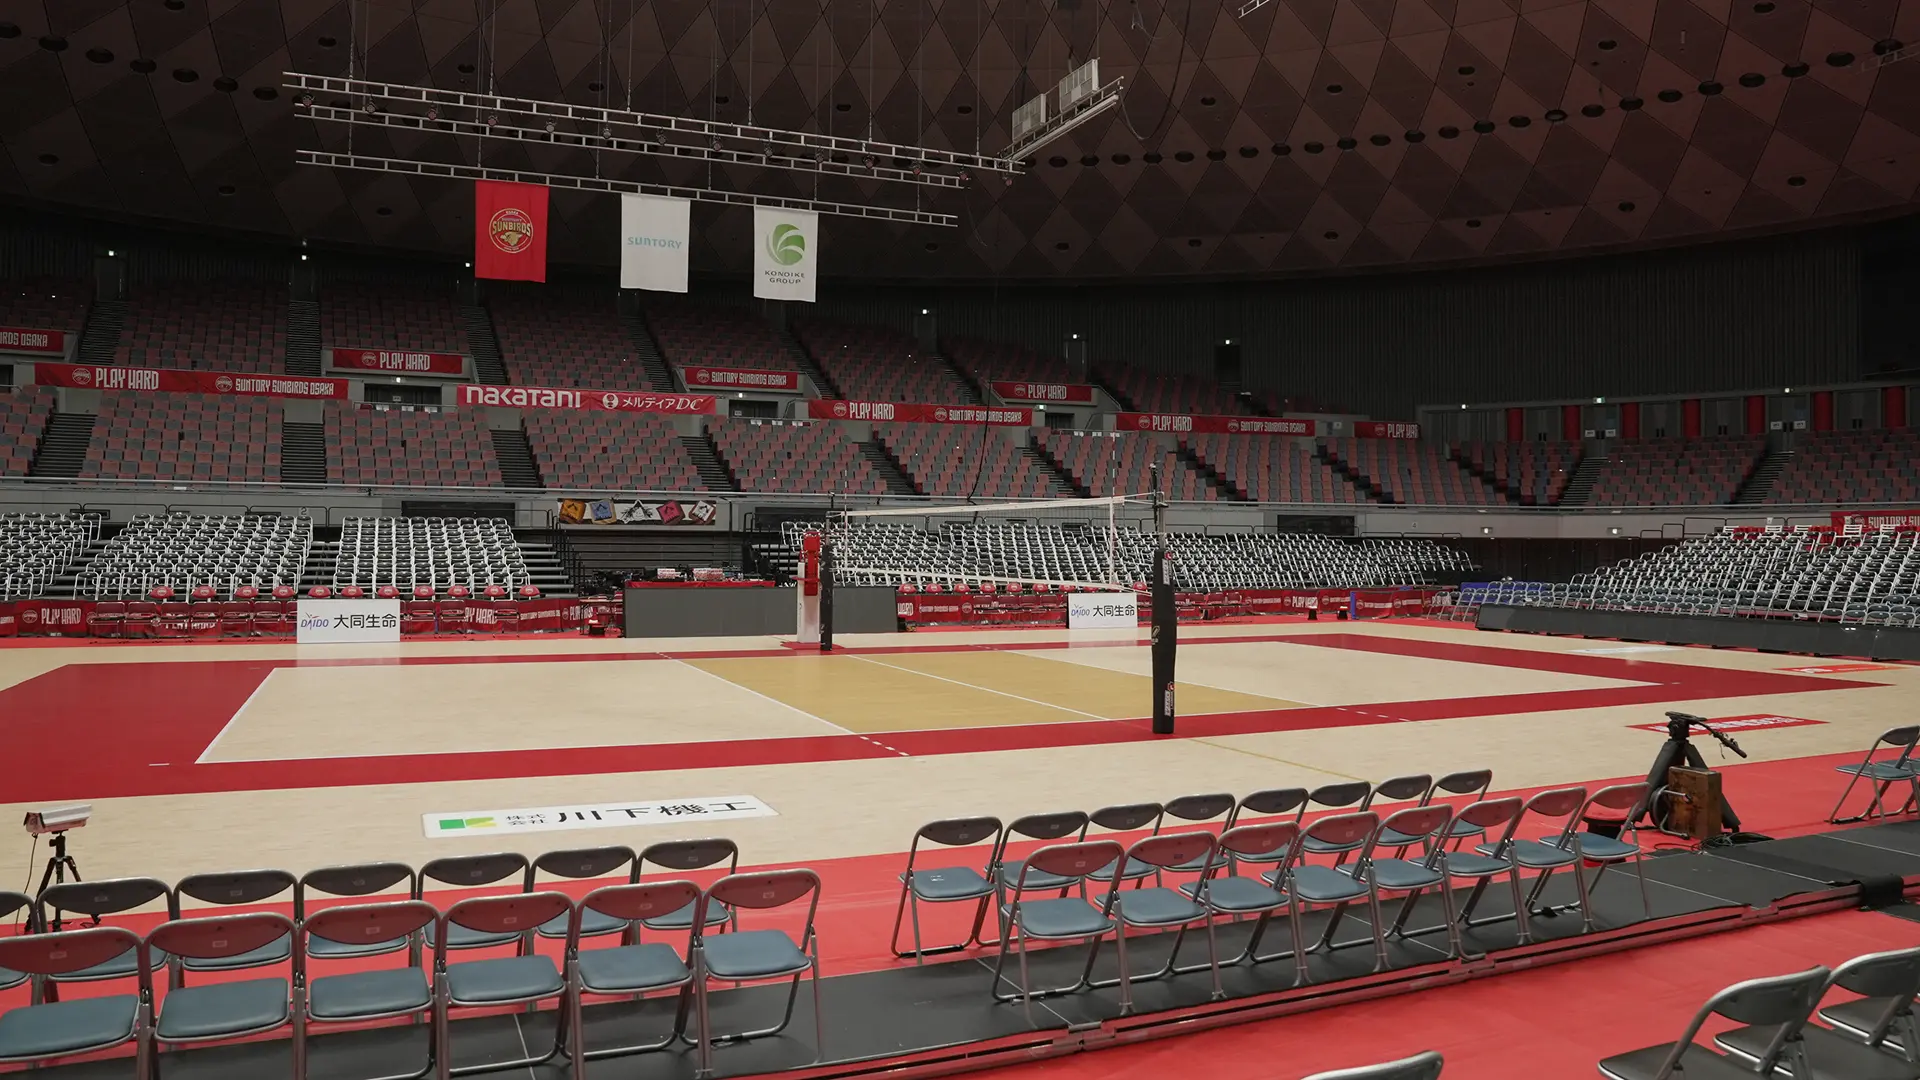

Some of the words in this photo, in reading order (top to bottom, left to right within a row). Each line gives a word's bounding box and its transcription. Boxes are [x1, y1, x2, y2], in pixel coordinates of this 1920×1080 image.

[492, 220, 531, 237] SUNBIRDS
[764, 270, 805, 278] KONOIKE
[21, 333, 48, 346] OSAKA
[380, 352, 404, 369] PLAY
[405, 353, 430, 370] HARD
[95, 368, 126, 388] PLAY
[128, 370, 159, 390] HARD
[711, 371, 738, 383] SUNTORY
[739, 373, 767, 384] SUNBIRDS
[768, 375, 787, 385] OSAKA
[235, 378, 270, 392] SUNTORY
[272, 380, 308, 394] SUNBIRDS
[310, 382, 334, 395] OSAKA
[1028, 385, 1046, 399] PLAY
[1047, 386, 1067, 399] HARD
[849, 402, 870, 419] PLAY
[872, 403, 894, 420] HARD
[949, 409, 974, 420] SUNTORY
[1152, 416, 1171, 431] PLAY
[1172, 417, 1192, 431] HARD
[1388, 424, 1405, 438] PLAY
[42, 608, 60, 624] PLAY
[61, 608, 81, 624] HARD
[1093, 605, 1135, 617] 大同生命
[333, 614, 397, 629] 大同生命
[558, 801, 757, 823] 川下機工
